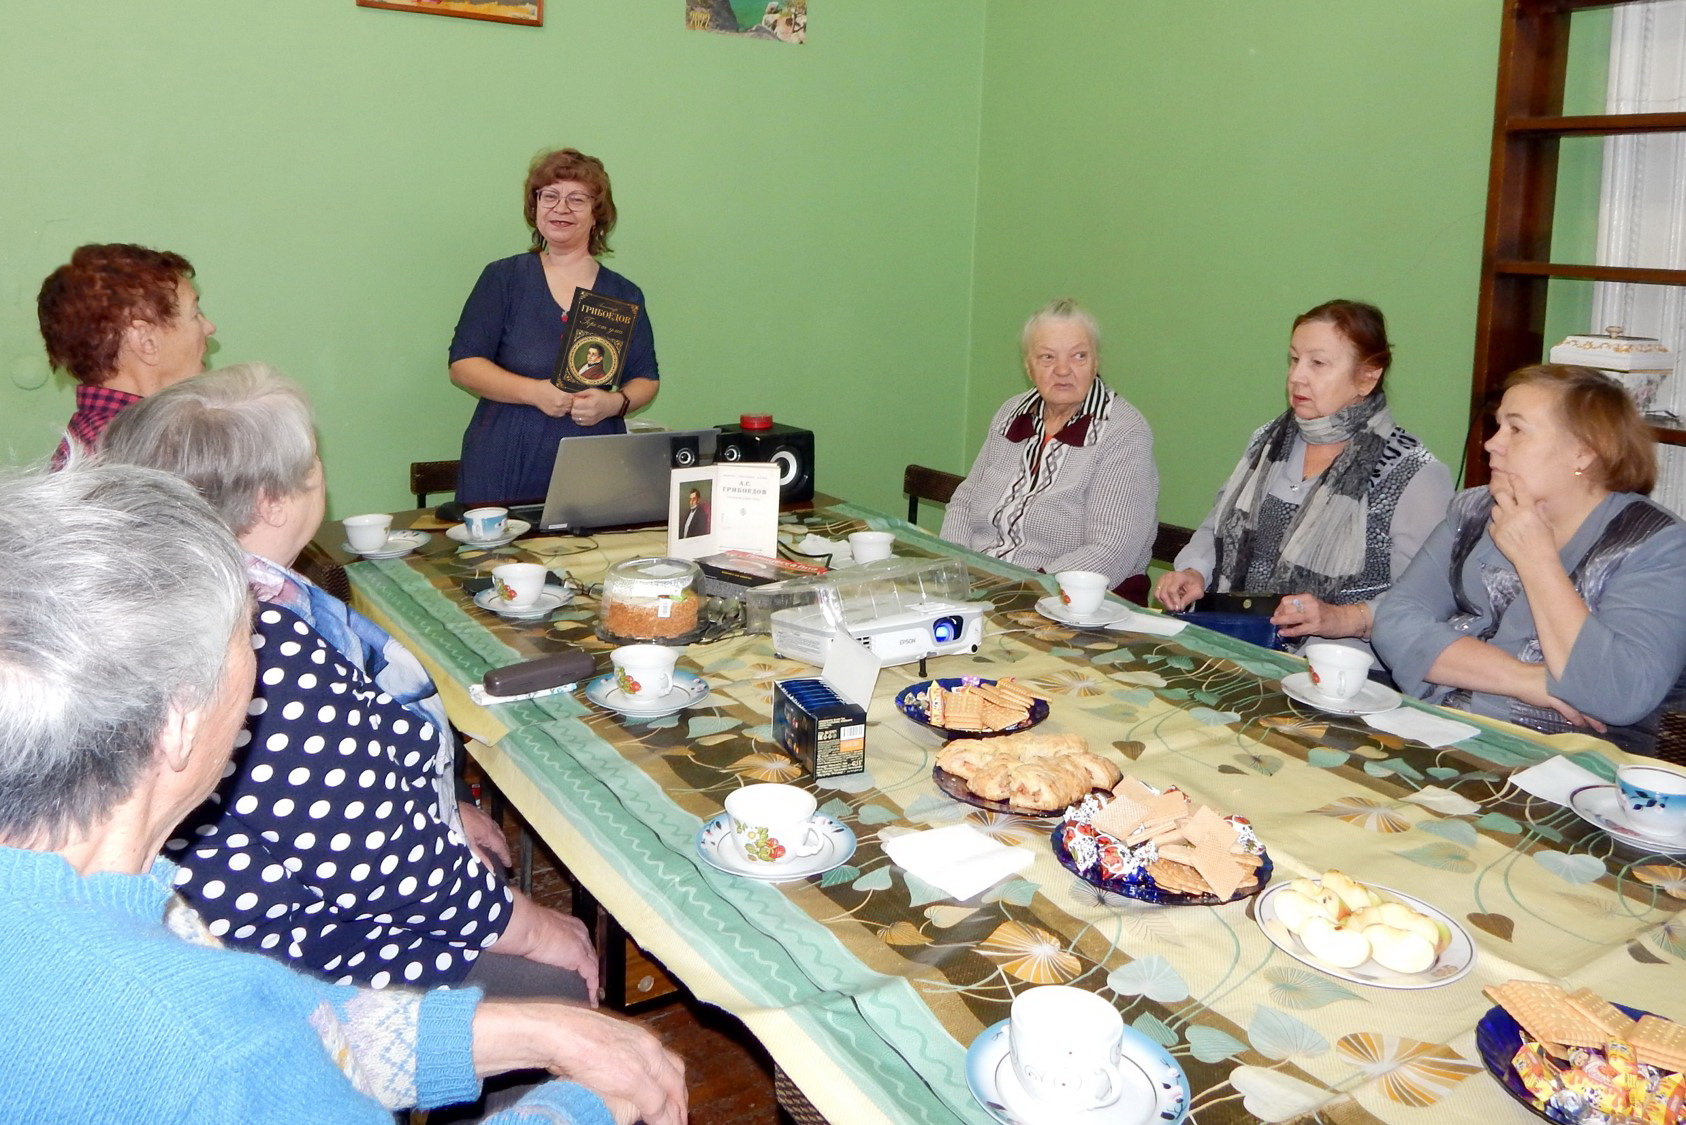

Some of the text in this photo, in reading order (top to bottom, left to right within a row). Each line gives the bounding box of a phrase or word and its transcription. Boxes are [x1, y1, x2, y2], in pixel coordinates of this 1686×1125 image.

[581, 304, 631, 324] ГРИБОЕДОВ
[722, 486, 767, 495] ГРИБОЕДОВ
[899, 638, 916, 646] EPSON
